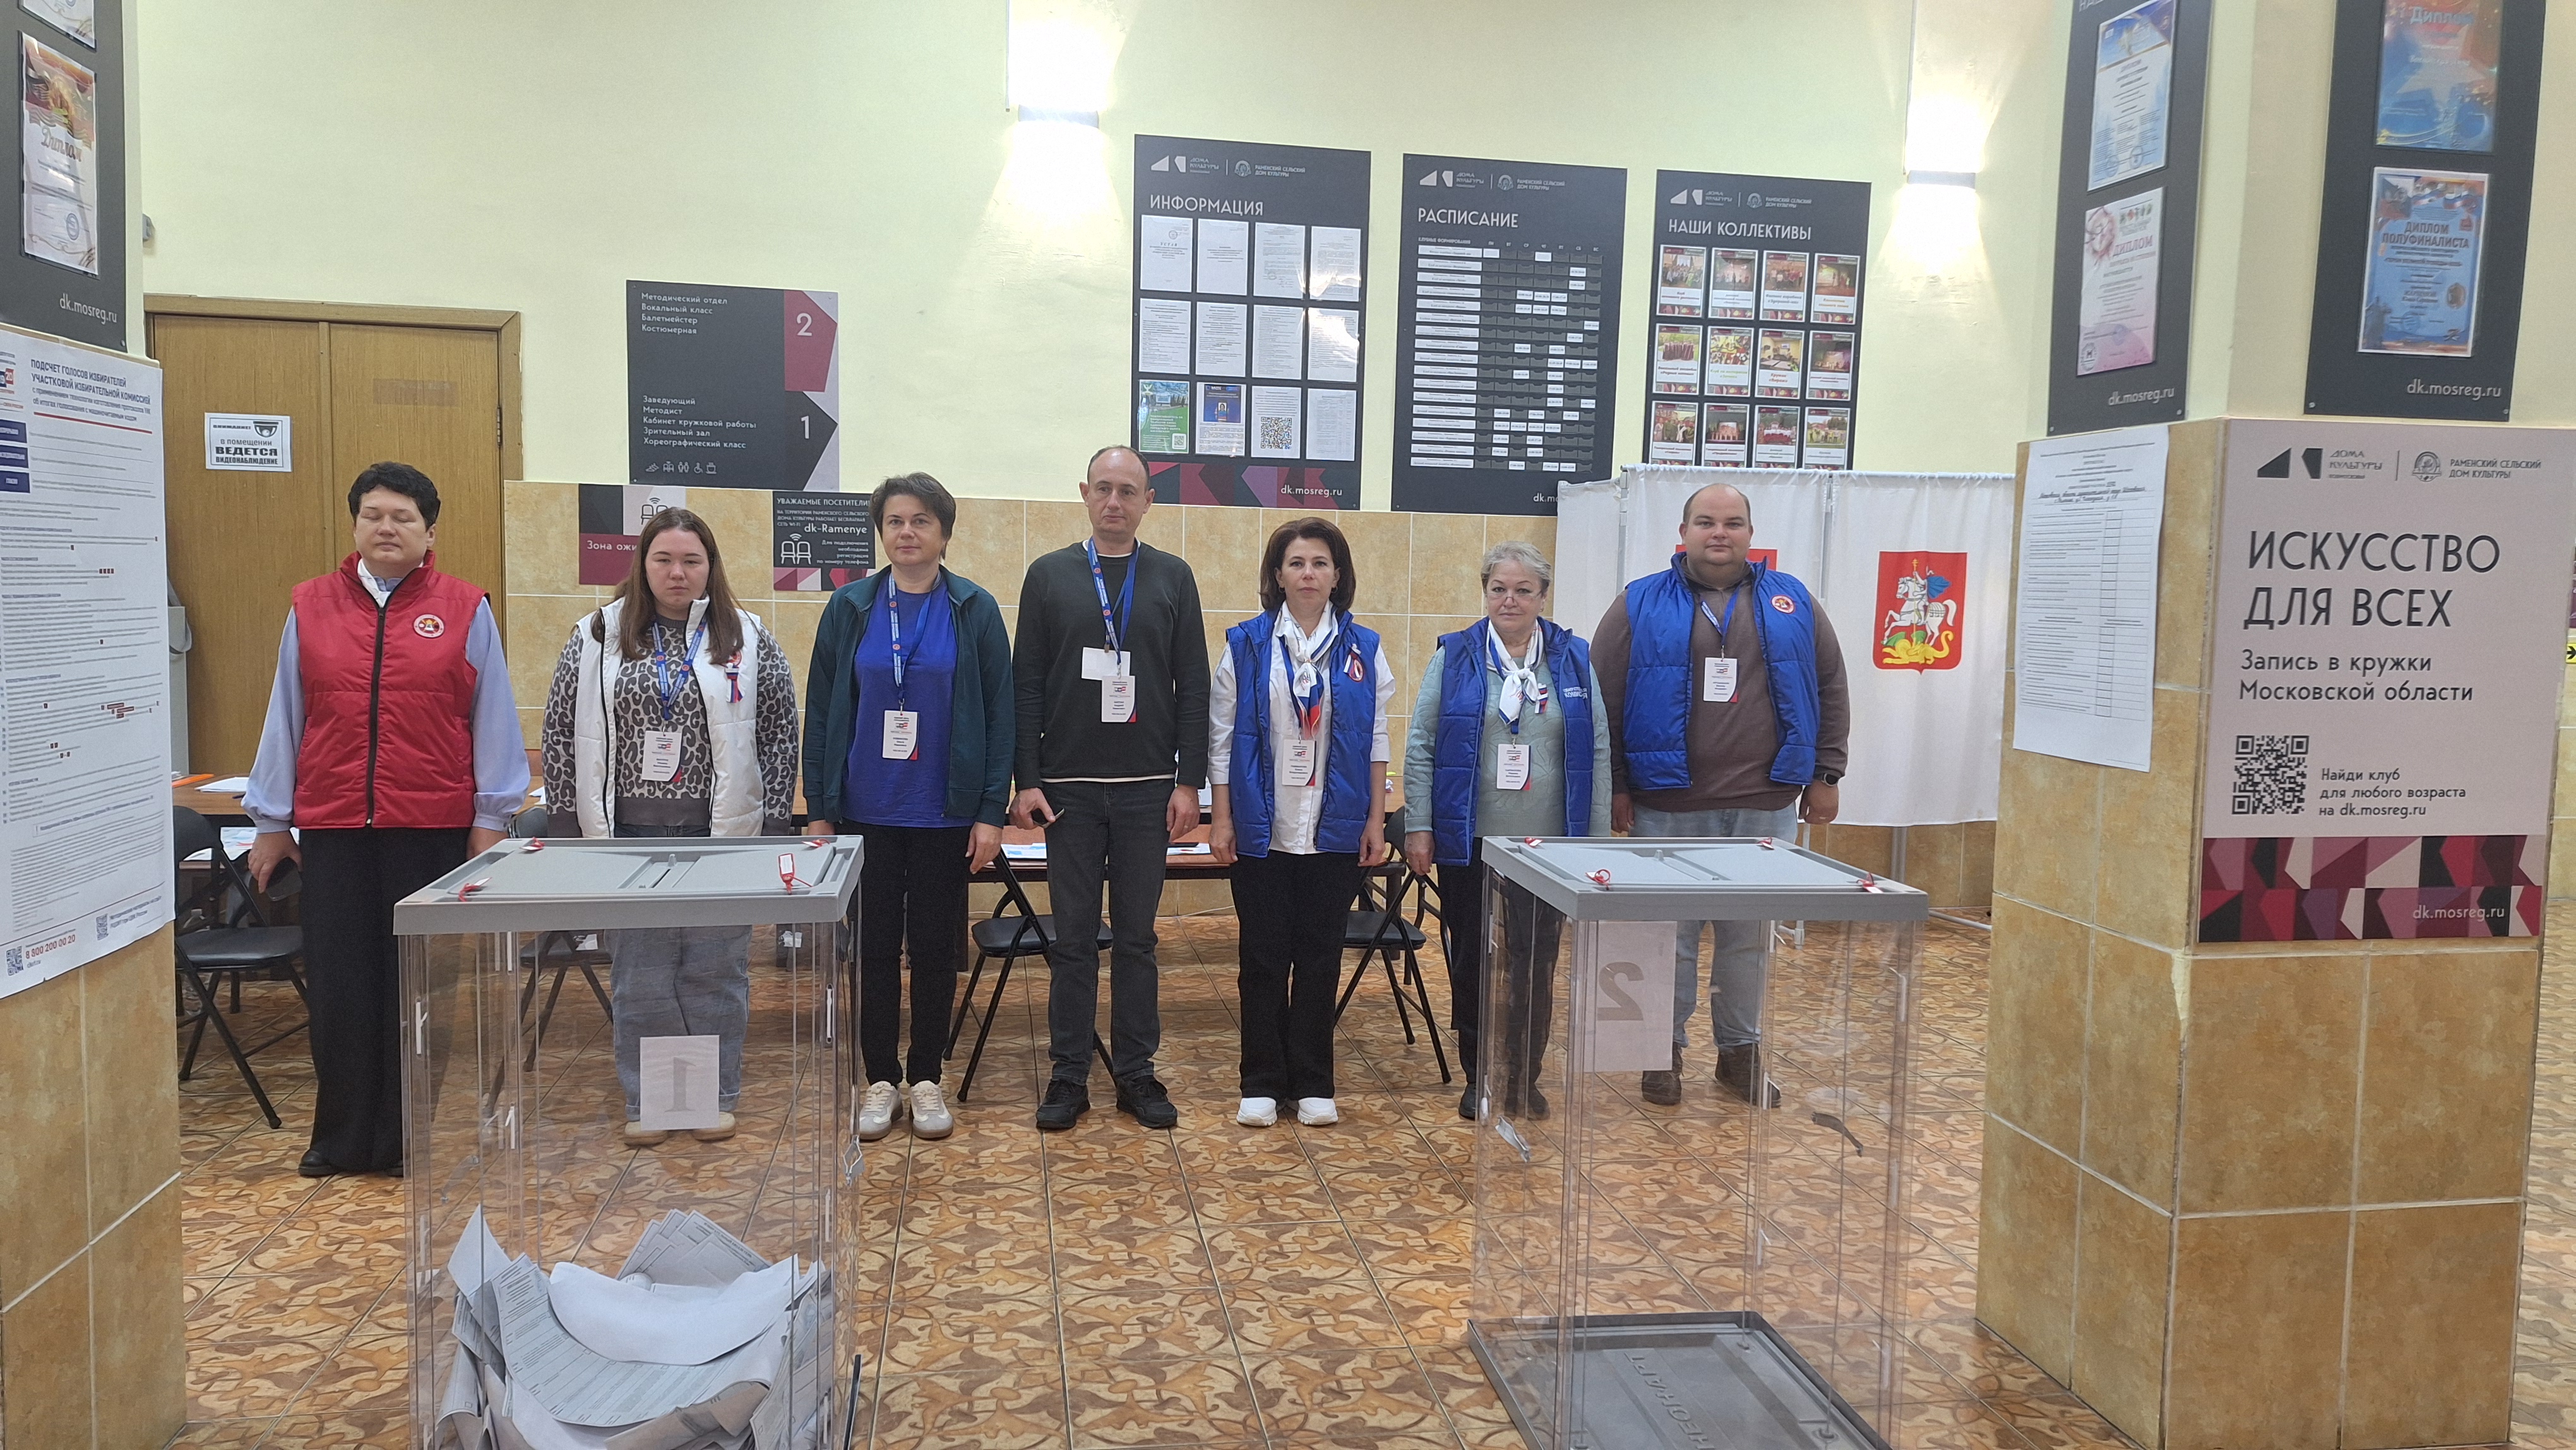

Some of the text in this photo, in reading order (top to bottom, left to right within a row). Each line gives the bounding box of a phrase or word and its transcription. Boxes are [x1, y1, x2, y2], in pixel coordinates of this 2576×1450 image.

[1150, 194, 1263, 216] ИНФОРМАЦИЯ
[1418, 207, 1518, 228] РАСПИСАНИЕ
[1669, 219, 1811, 240] НАШИ КОЛЛЕКТИВЫ
[2404, 222, 2449, 234] ДИПЛОМ
[2382, 233, 2469, 248] ПОЛУФИНАЛИСТА
[641, 292, 701, 304] Методический
[59, 293, 117, 325] dk.mosreg.ru
[641, 303, 688, 313] Вокальный
[641, 314, 698, 325] Балетмейстер
[796, 313, 813, 337] 2
[641, 324, 697, 335] Костюмерная
[31, 359, 126, 388] ПОДСЧЕТ ГОЛОСОВ ИЗБИРАТЕЛЕЙ
[32, 373, 151, 405] УЧАСТКОВОЙ ИЗБИРАТЕЛЬНОЙ КОМИССИЕЙ
[2108, 386, 2174, 406] dk.mosreg.ru
[2407, 379, 2501, 401] dk.mosreg.ru
[643, 395, 696, 406] Заведующий
[643, 406, 683, 415] Методист
[643, 417, 756, 429] Кабинет кружковой работы
[801, 416, 810, 439] 1
[643, 427, 693, 436] Зрительный
[643, 437, 720, 448] Хореографический
[215, 446, 278, 457] ВЕДЕТСЯ
[215, 457, 278, 465] ВИДЕОНАБЛЮДЕНИЕ
[2330, 462, 2382, 470] КУЛЬТУРЫ
[2450, 458, 2541, 469] РАМЕНСКИЙ СЕЛЬСКИЙ
[2472, 470, 2511, 479] КУЛЬТУРЫ
[1280, 484, 1343, 498] dk.mosreg.ru
[804, 523, 868, 536] dk-Ramenye
[587, 540, 612, 550] Зона
[2248, 530, 2500, 573] ИСКУССТВО
[2243, 587, 2453, 630] ДЛЯ ВСЕХ
[2241, 649, 2431, 677] Запись в кружки
[2239, 679, 2473, 701] Московской области
[2322, 768, 2400, 783] Найди клуб
[2320, 787, 2466, 802] для любого возраста
[2320, 803, 2426, 818] на dk.mosreg.ru
[2412, 906, 2505, 922] dk.mosreg.ru
[31, 946, 44, 957] 800
[45, 941, 57, 952] 200
[58, 937, 66, 947] 00
[68, 934, 76, 944] 20
